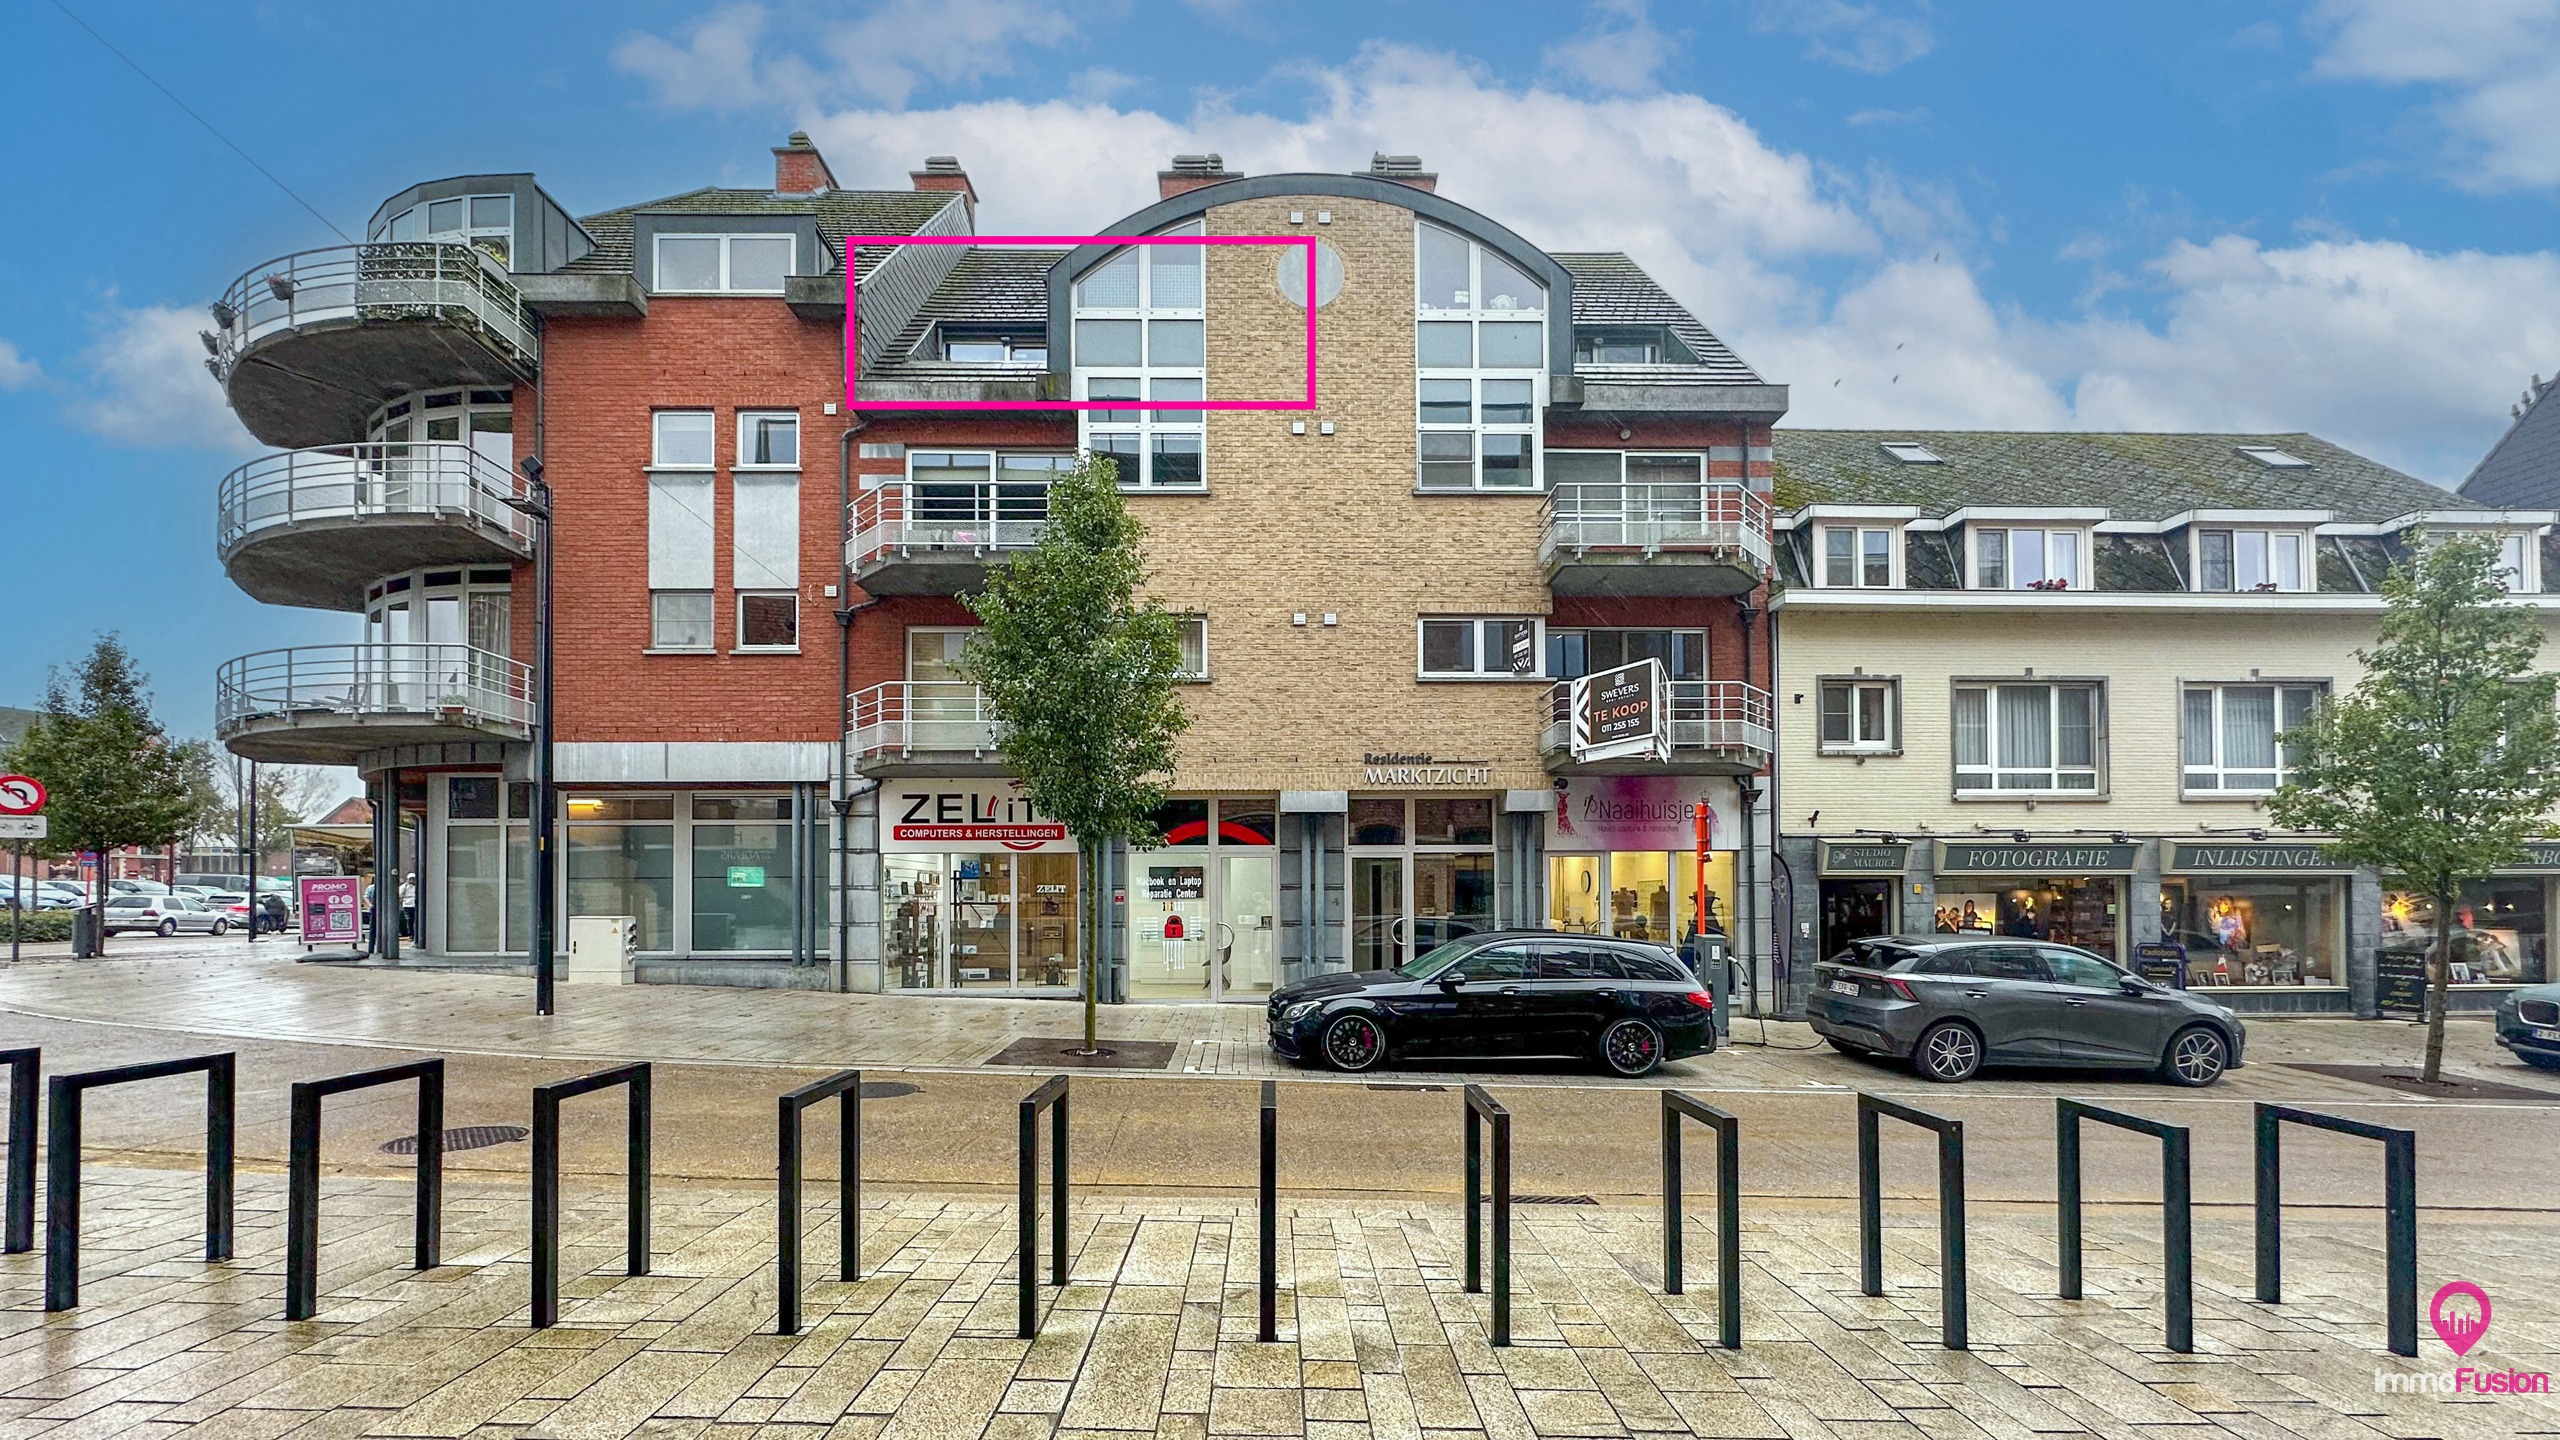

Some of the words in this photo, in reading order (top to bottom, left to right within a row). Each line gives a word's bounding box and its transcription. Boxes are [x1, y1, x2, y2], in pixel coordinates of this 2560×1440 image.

[1601, 683, 1640, 701] SWEVERS
[1593, 709, 1608, 722] TE
[1612, 700, 1648, 719] KOOP
[1601, 723, 1612, 733] 011
[1613, 720, 1627, 731] 255
[1627, 717, 1640, 728] 155
[1364, 752, 1432, 765] Residentie
[1364, 767, 1492, 784] MARKTZICHT
[1600, 799, 1694, 824] Naaihuisje
[900, 828, 963, 838] COMPUTERS
[965, 829, 972, 838] &
[975, 828, 1058, 838] HERSTELLINGEN
[1853, 848, 1891, 857] STUDIO
[1967, 850, 2110, 867] FOTOGRAFIE
[1853, 859, 1897, 867] MAURICE
[312, 883, 348, 891] PROMO
[1136, 876, 1165, 886] Macbook
[1168, 877, 1177, 886] en
[1180, 876, 1202, 887] Laptop
[1036, 884, 1067, 893] ZELIT
[1142, 889, 1172, 900] Reparatie
[1176, 889, 1198, 898] Center
